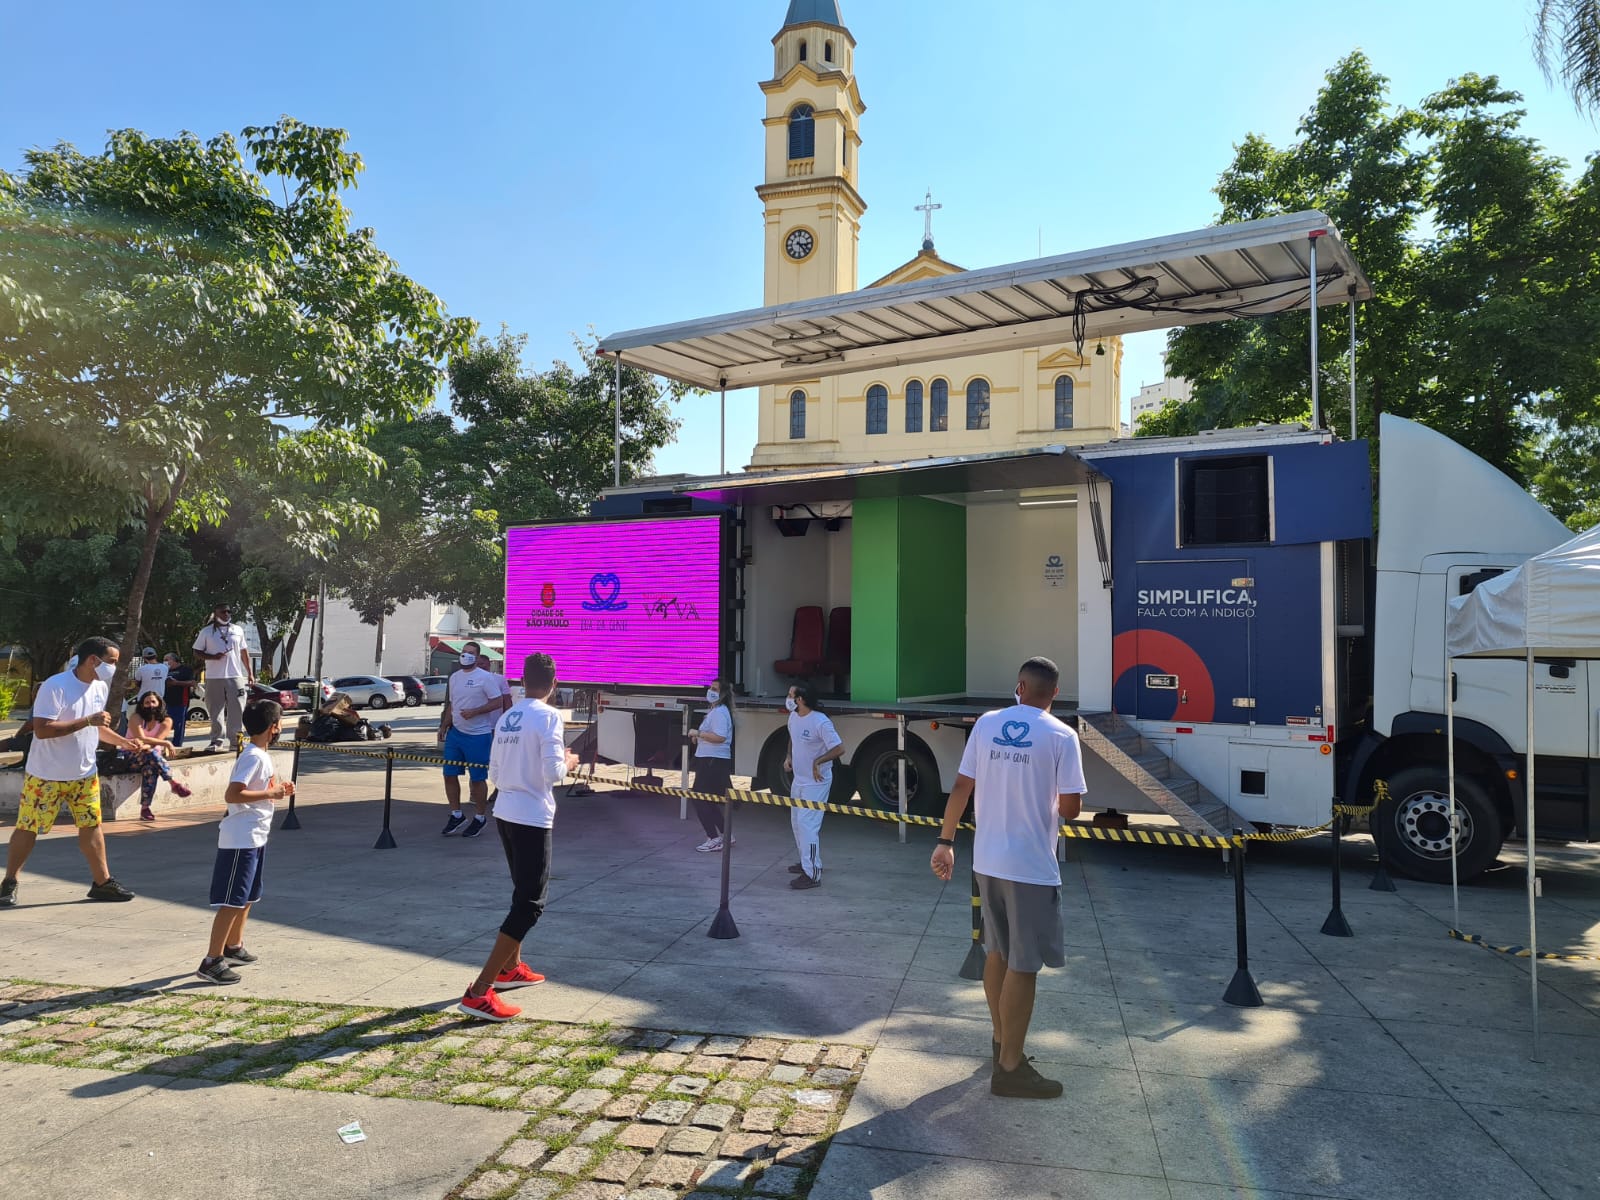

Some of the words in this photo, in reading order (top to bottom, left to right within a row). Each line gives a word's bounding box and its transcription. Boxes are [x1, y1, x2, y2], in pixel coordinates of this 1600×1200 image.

[1137, 590, 1257, 608] SIMPLIFICA,
[1137, 608, 1167, 618] FALA
[1170, 608, 1197, 618] COM
[1199, 608, 1209, 618] A
[544, 619, 570, 627] PAULO
